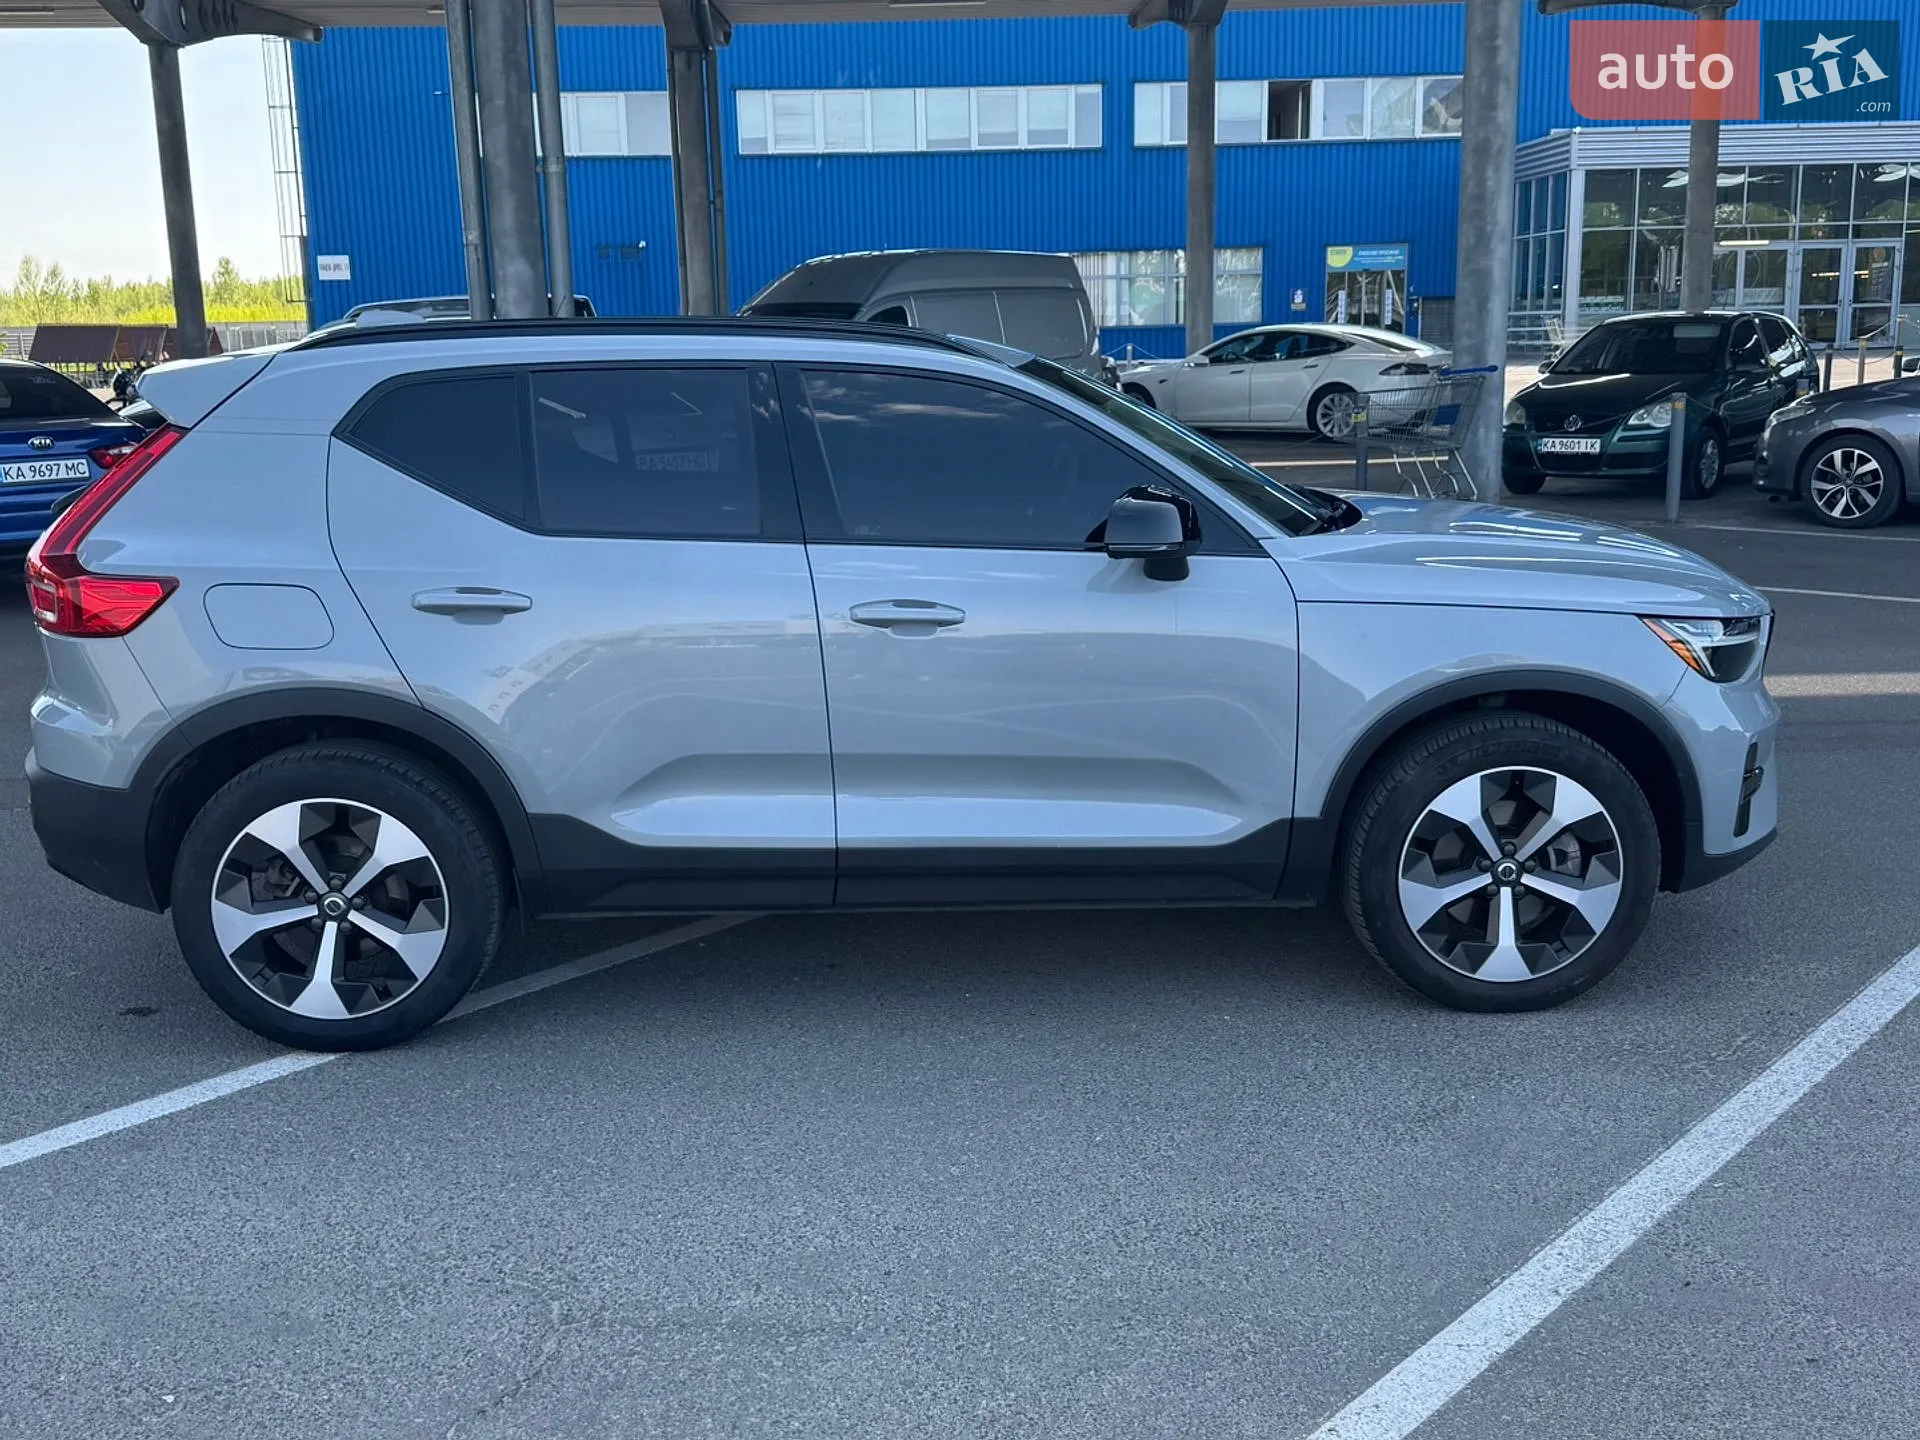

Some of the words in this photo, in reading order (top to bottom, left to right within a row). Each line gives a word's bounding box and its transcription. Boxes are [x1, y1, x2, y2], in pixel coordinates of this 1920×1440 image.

[1543, 440, 1556, 450] KA
[1558, 440, 1581, 450] 9601
[1585, 440, 1597, 450] IK
[3, 465, 26, 481] KA
[28, 462, 61, 479] 9697
[66, 461, 86, 477] MC
